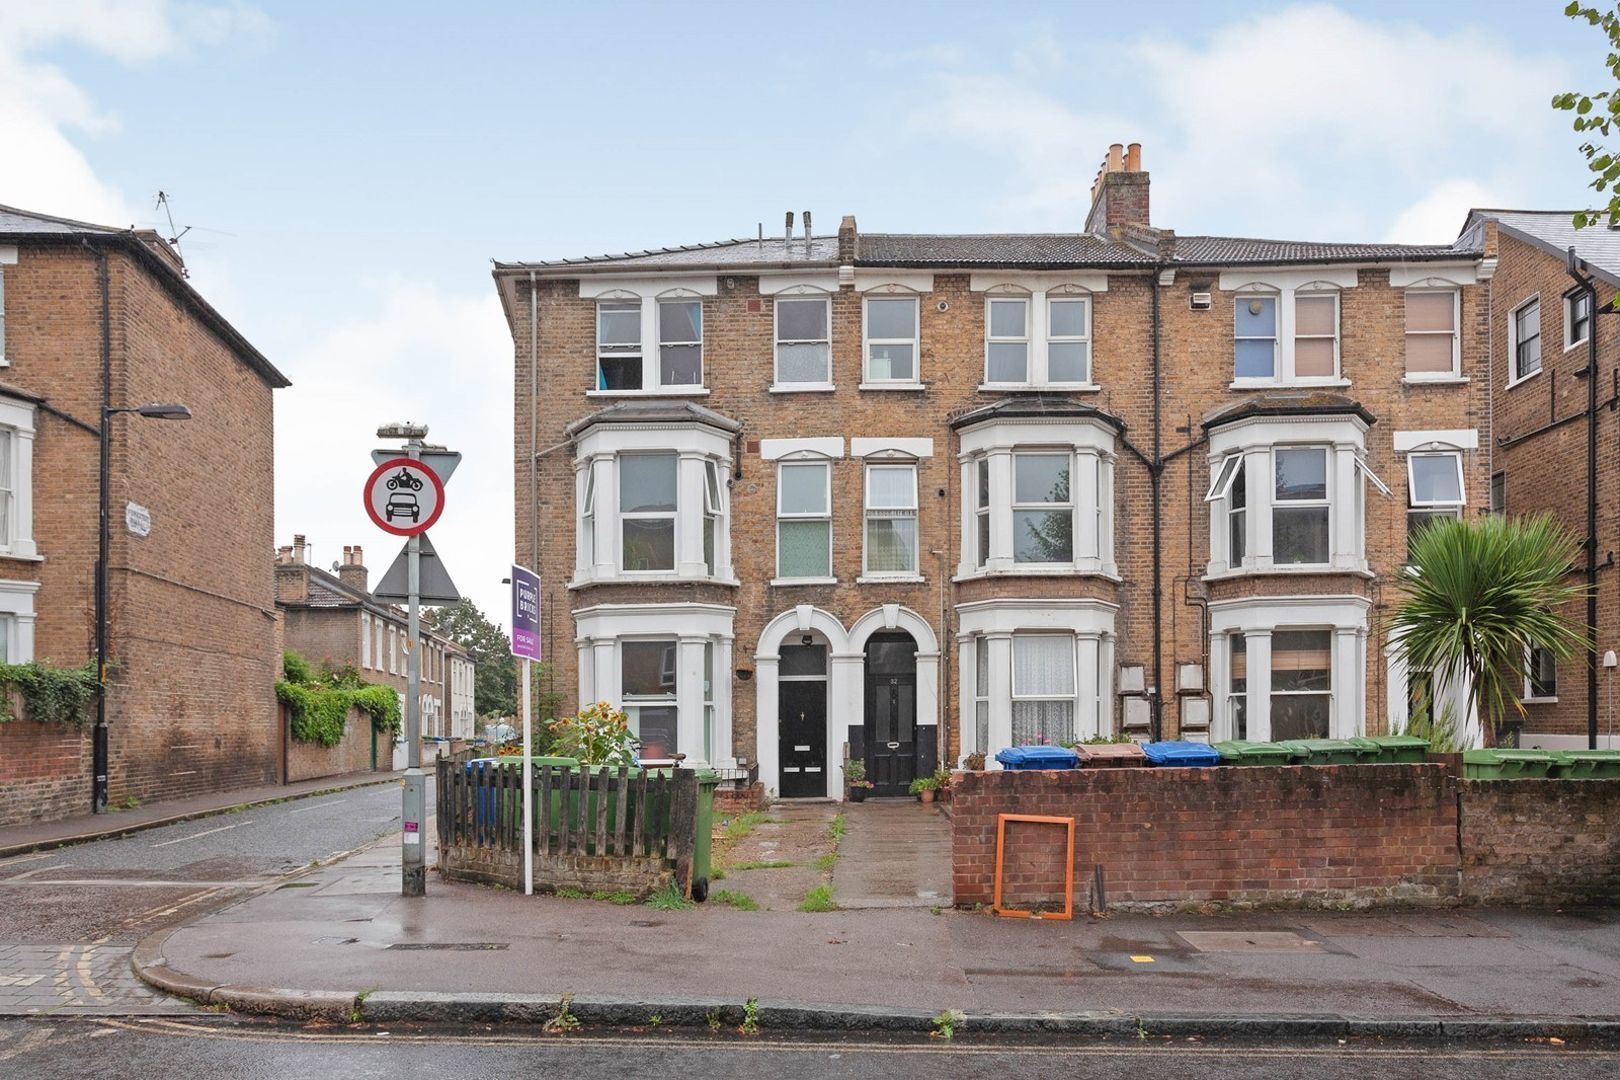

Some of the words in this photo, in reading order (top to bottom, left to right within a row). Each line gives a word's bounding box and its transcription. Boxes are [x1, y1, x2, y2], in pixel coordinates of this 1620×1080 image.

[520, 588, 536, 603] PURPLE
[520, 600, 536, 615] BRICKS
[517, 634, 525, 642] FOR
[526, 637, 534, 645] SALE
